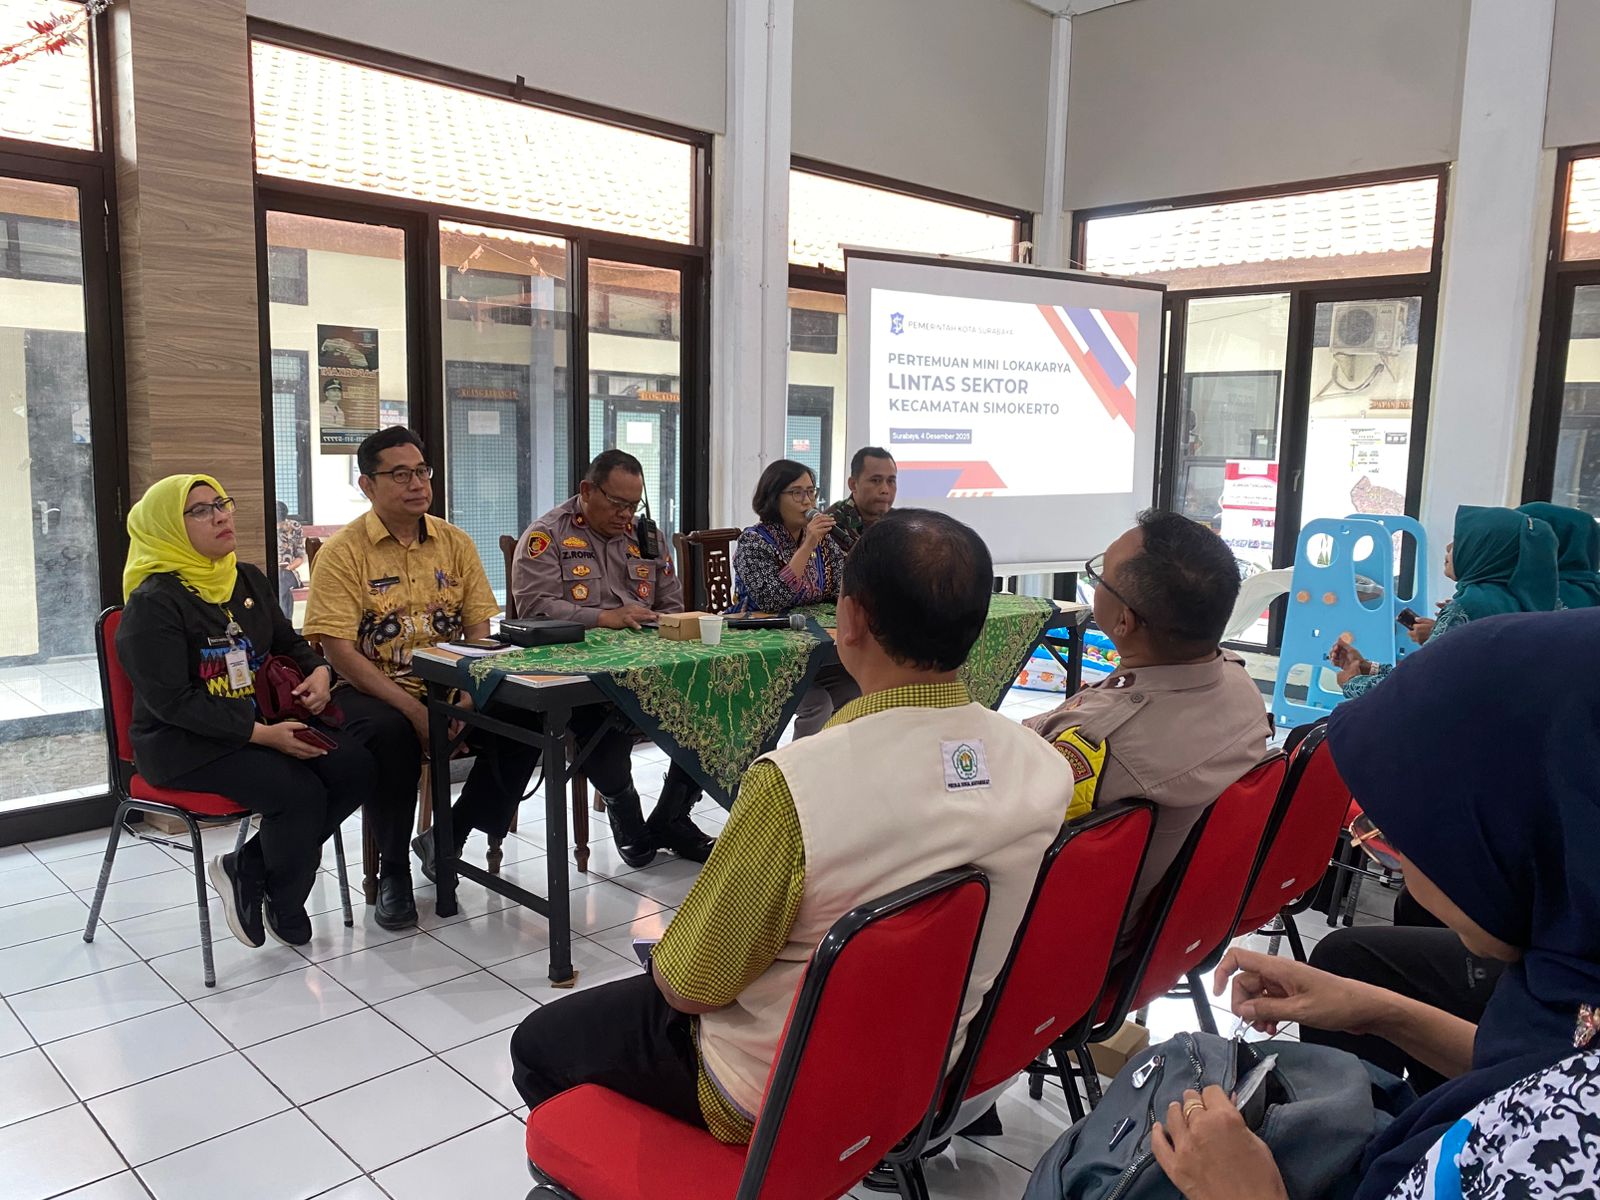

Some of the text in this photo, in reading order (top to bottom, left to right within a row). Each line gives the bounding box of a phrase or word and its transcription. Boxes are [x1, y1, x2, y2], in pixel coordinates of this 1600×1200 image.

[908, 320, 1014, 336] PEMERINTAH KOTA SURABAYA
[888, 352, 1071, 374] PERTEMUAN MINI LOKAKARYA
[888, 372, 1029, 395] LINTAS SEKTOR
[888, 398, 1060, 415] KECAMATAN SIMOKERTO
[920, 432, 925, 440] 4
